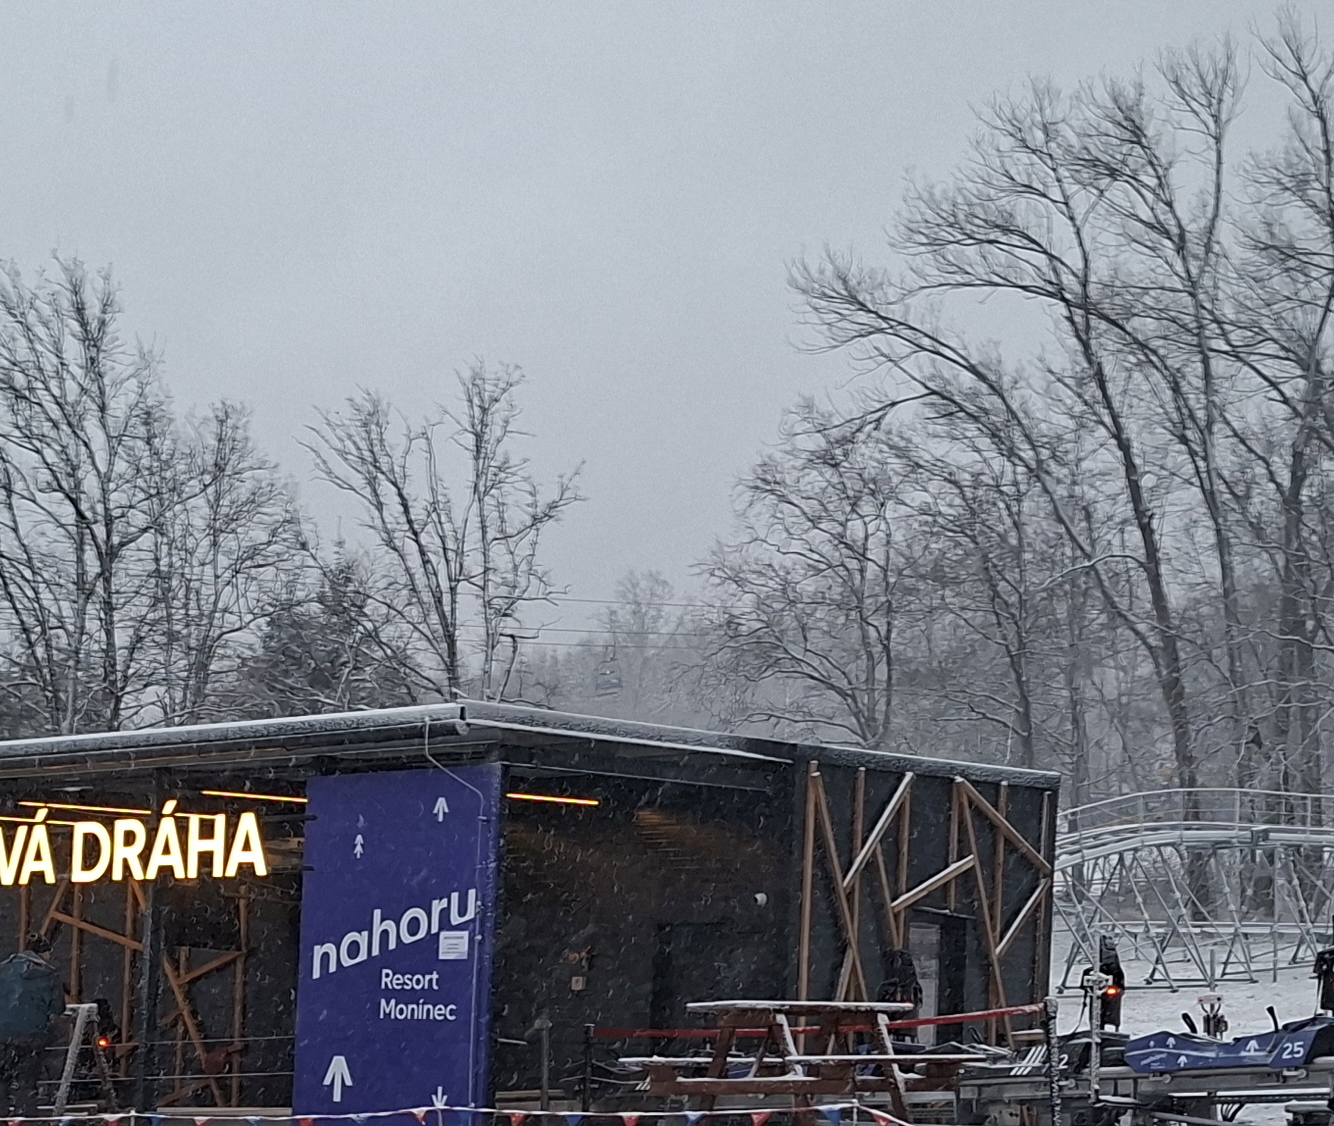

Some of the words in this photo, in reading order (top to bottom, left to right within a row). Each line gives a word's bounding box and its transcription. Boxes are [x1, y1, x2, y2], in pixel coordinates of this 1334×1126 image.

[70, 799, 267, 883] DRÁHA
[311, 888, 477, 980] nahoru
[381, 968, 439, 991] Resort
[379, 998, 457, 1021] Monínec
[1281, 1041, 1305, 1059] 25
